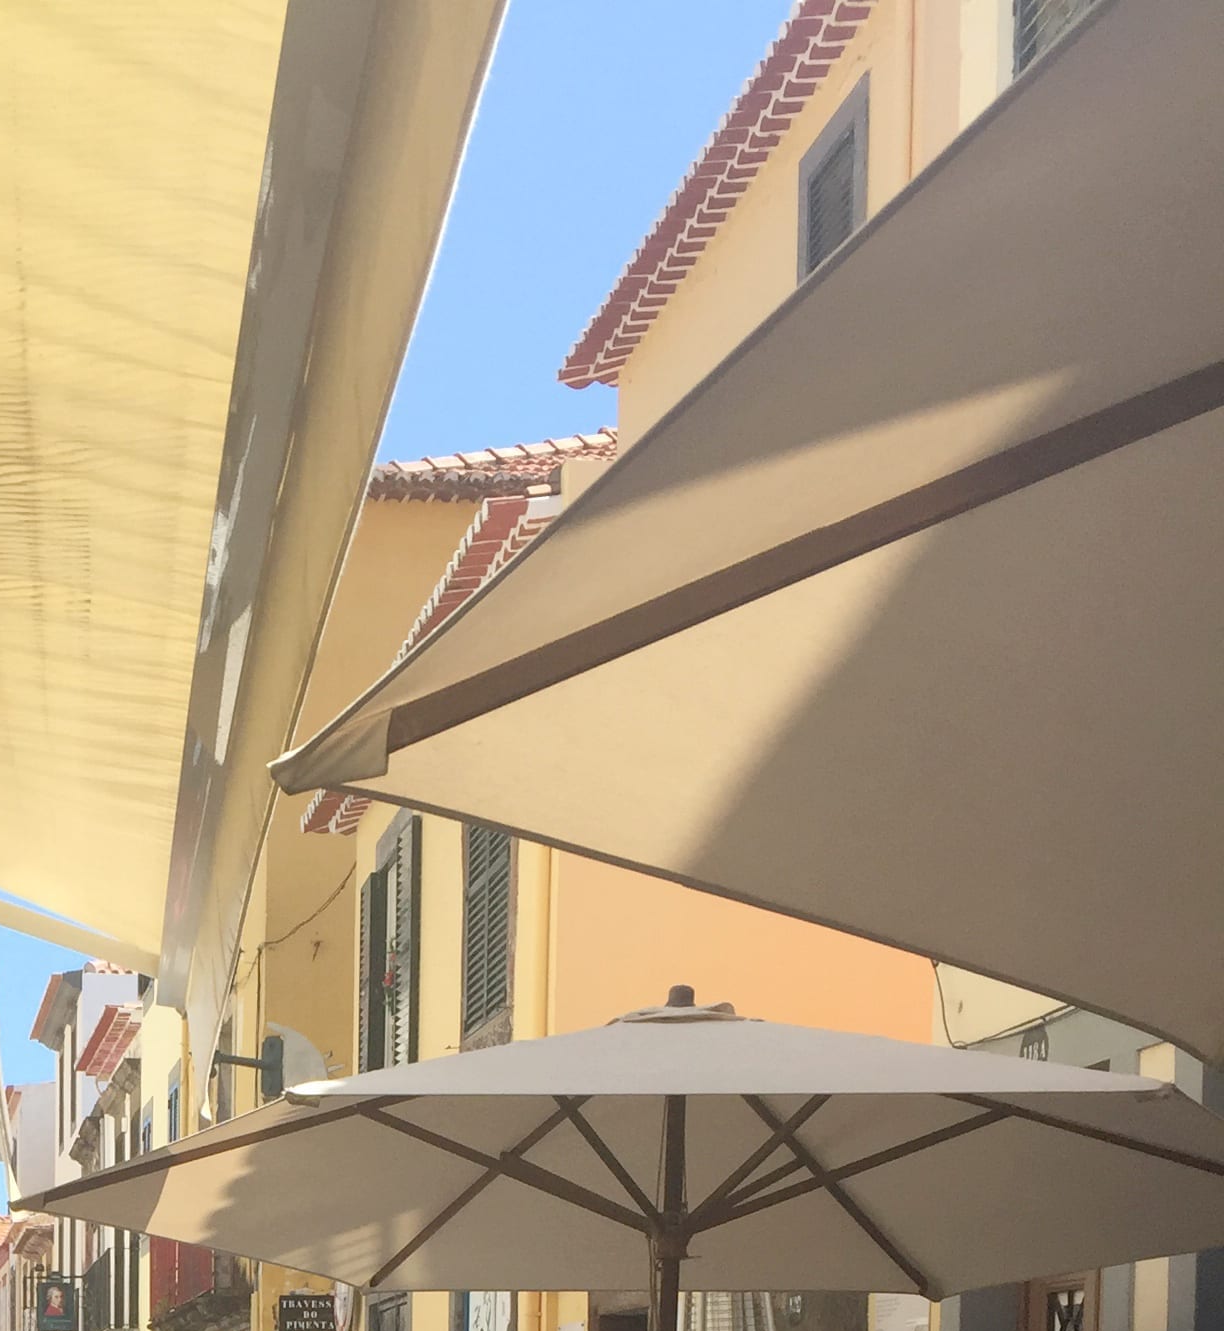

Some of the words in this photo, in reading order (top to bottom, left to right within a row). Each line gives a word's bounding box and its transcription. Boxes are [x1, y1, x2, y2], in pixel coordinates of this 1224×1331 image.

[281, 1299, 334, 1309] TRAVESS
[303, 1310, 318, 1319] DO
[285, 1320, 335, 1330] PIMENTA
